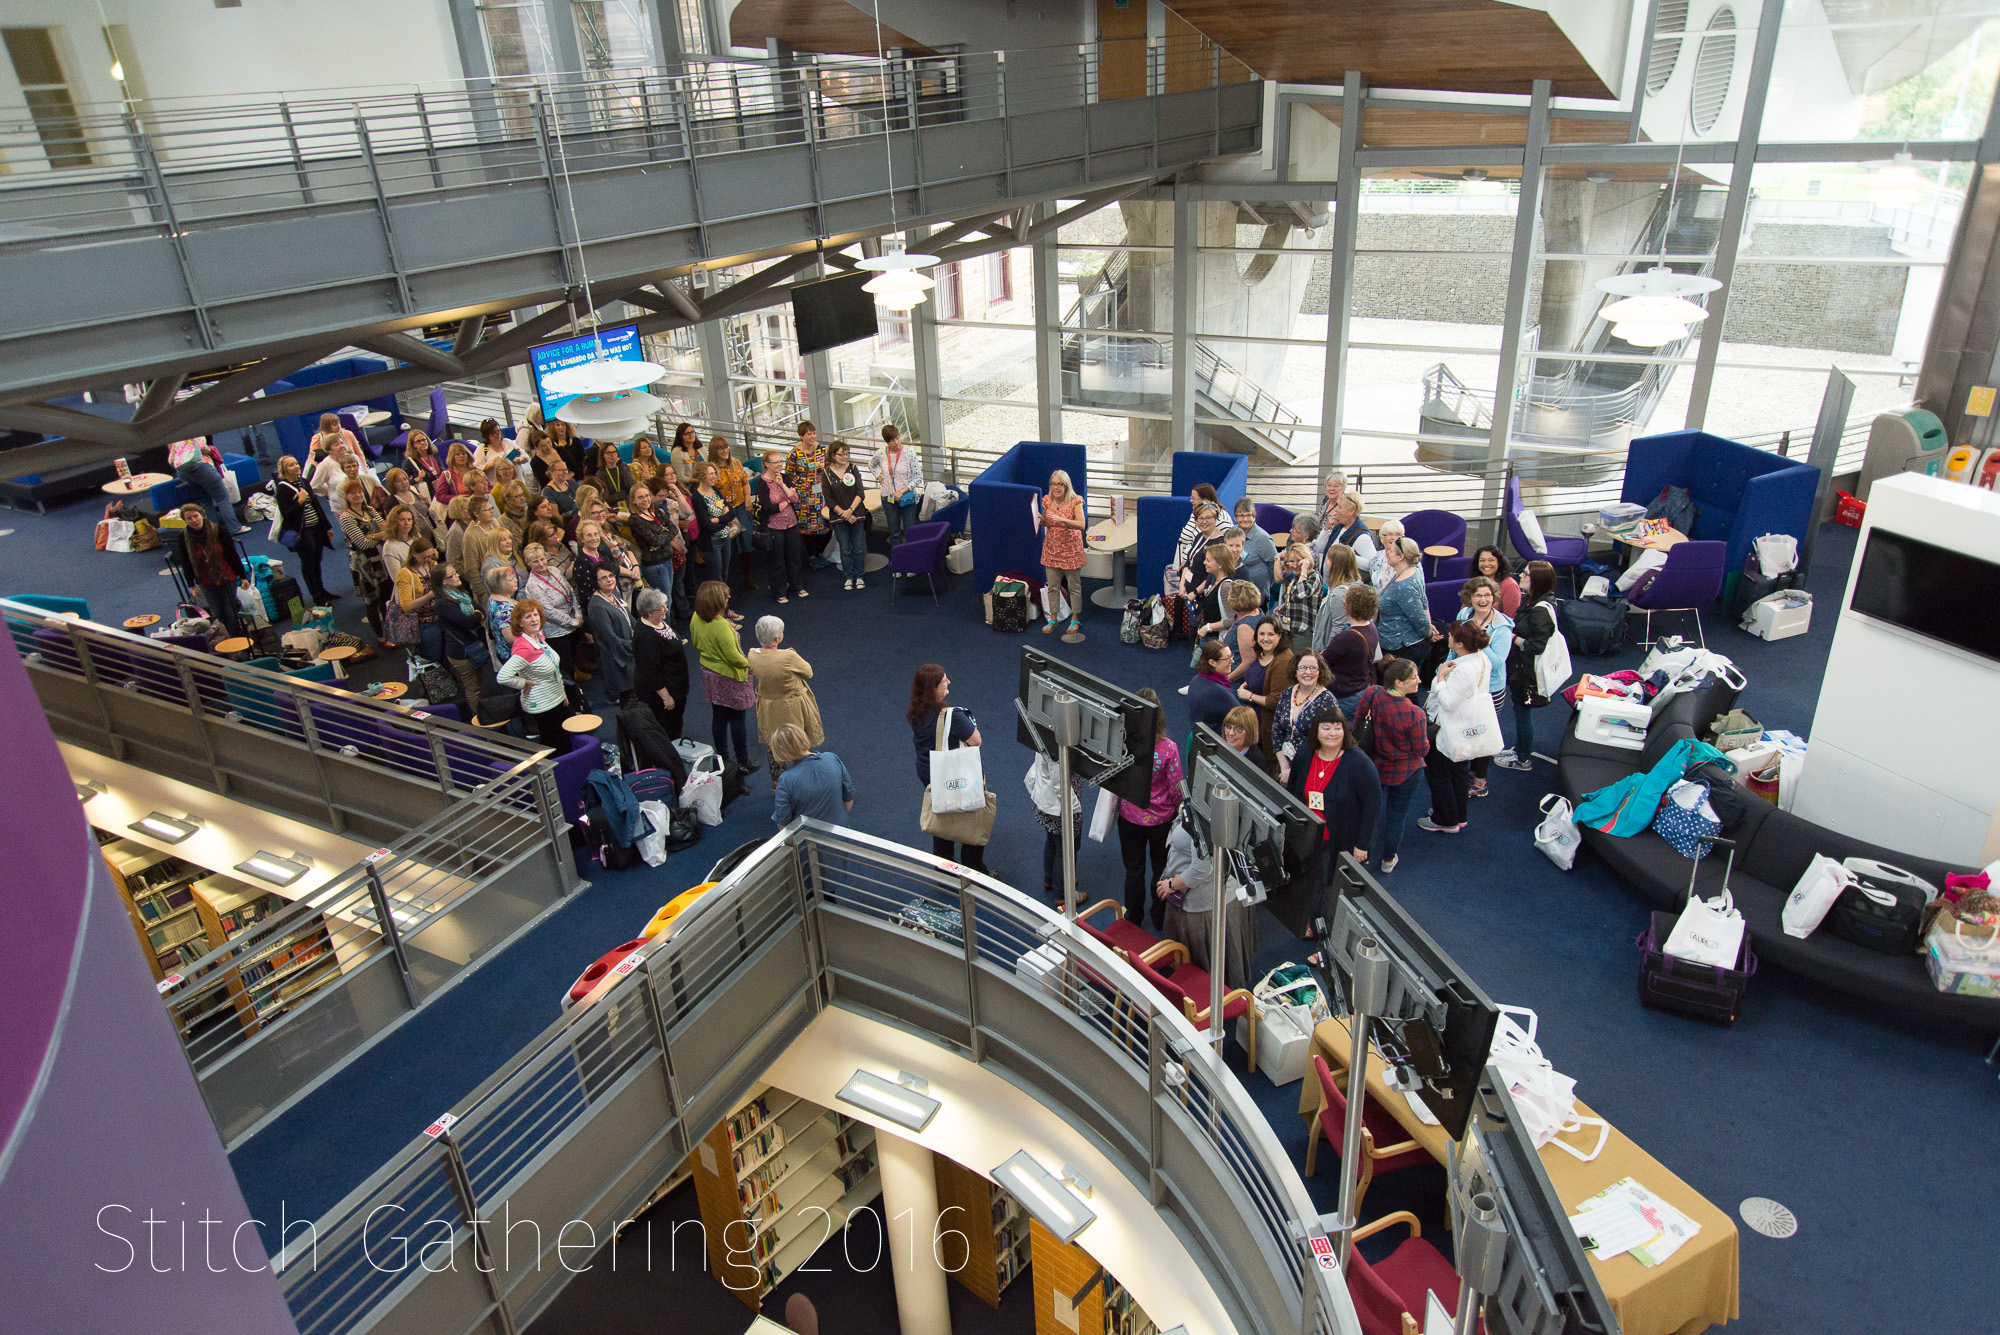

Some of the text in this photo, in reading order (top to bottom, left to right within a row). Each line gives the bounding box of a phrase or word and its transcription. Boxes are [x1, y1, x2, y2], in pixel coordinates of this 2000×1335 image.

[537, 338, 603, 361] ADVICE FOR A HUM
[586, 351, 596, 360] DA
[609, 345, 622, 354] WAS
[622, 342, 632, 351] NOT
